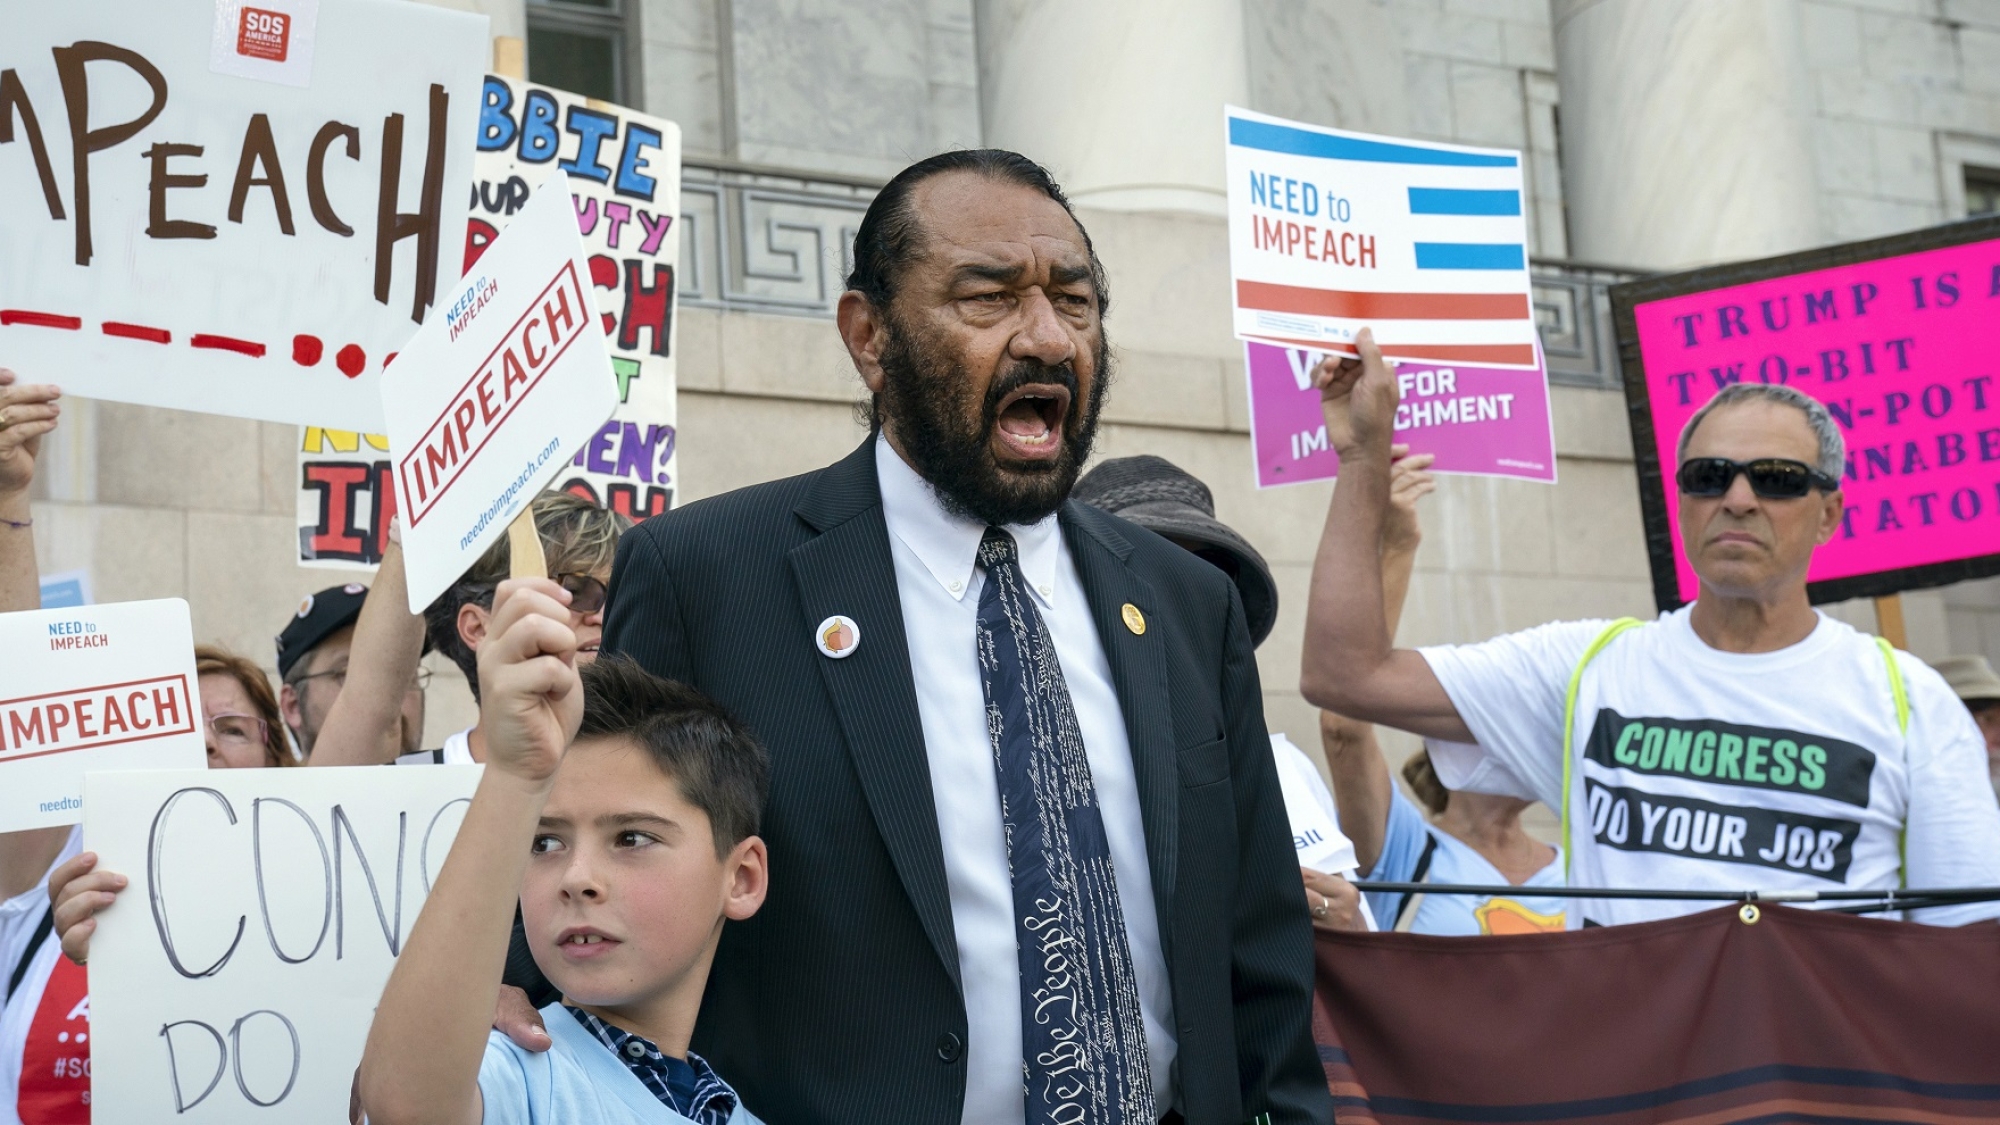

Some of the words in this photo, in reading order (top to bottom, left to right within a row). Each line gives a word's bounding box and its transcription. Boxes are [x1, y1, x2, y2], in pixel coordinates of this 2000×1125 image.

[245, 31, 282, 44] AMERICA
[246, 12, 284, 35] SOS
[1249, 169, 1319, 217] NEED
[1327, 190, 1351, 223] to
[1252, 214, 1377, 269] IMPEACH
[446, 289, 475, 326] NEED
[476, 276, 487, 291] to
[450, 278, 499, 343] IMPEACH
[1674, 282, 1880, 347] TRUMP
[1910, 272, 1961, 310] IS
[413, 285, 574, 504] IMPEACH
[1398, 368, 1457, 400] FOR
[1668, 338, 1915, 406] TWO-BIT
[574, 420, 677, 485] EN?
[460, 437, 560, 551] needtoimpeach.com
[1842, 482, 2000, 540] TATO
[49, 621, 82, 636] NEED
[85, 622, 96, 633] to
[51, 634, 108, 650] IMPEACH
[1614, 722, 1828, 790] CONGRESS
[1589, 784, 1630, 845] DO
[1640, 801, 1748, 858] YOUR
[1758, 823, 1844, 872] JOB
[160, 1009, 300, 1115] DO
